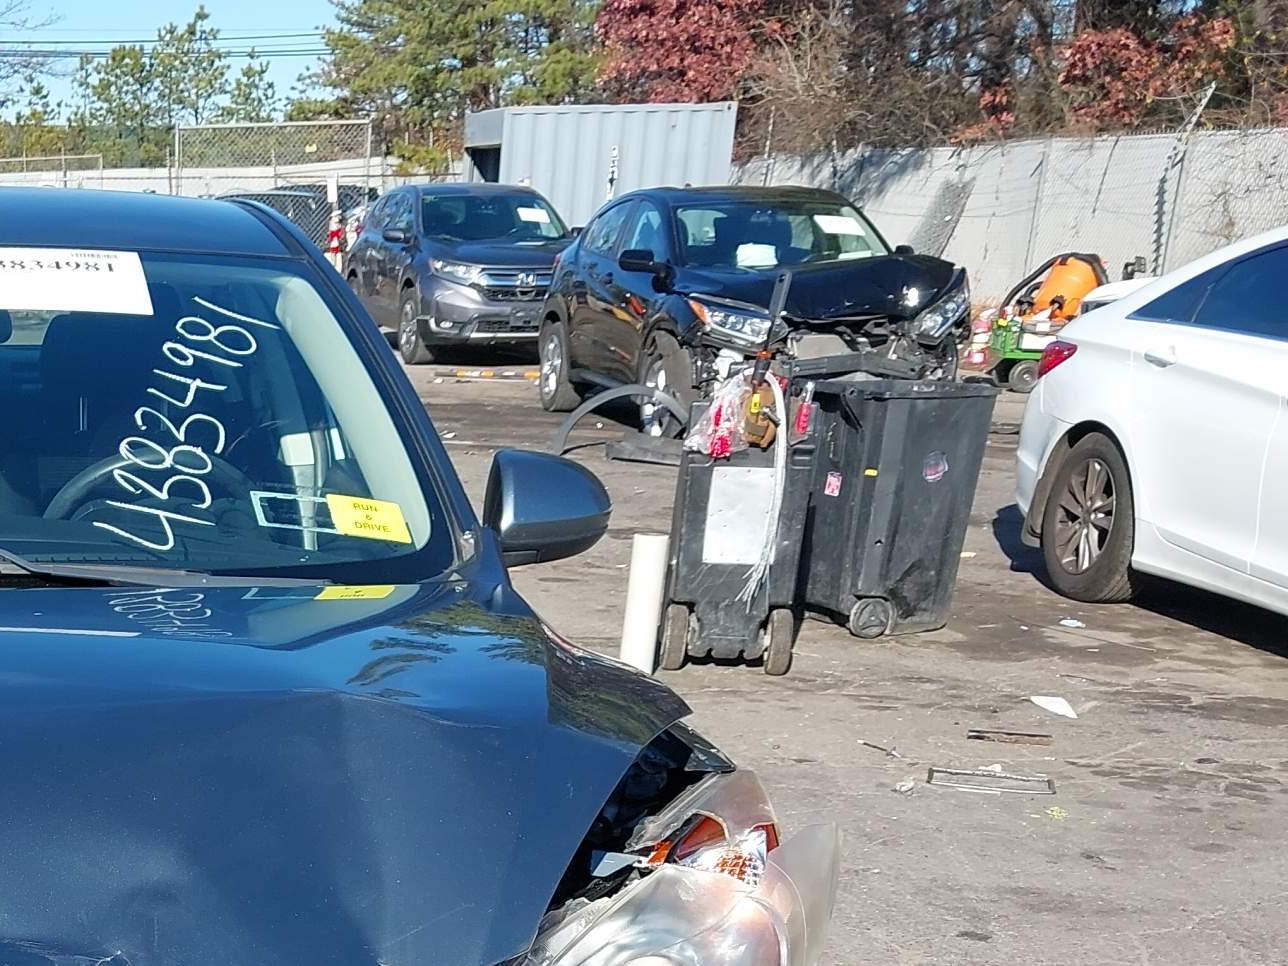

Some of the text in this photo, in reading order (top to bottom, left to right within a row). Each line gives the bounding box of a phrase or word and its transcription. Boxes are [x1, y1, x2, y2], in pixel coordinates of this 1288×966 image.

[92, 296, 281, 551] 43834981
[353, 503, 378, 512] RUN
[355, 522, 391, 532] DRIVE
